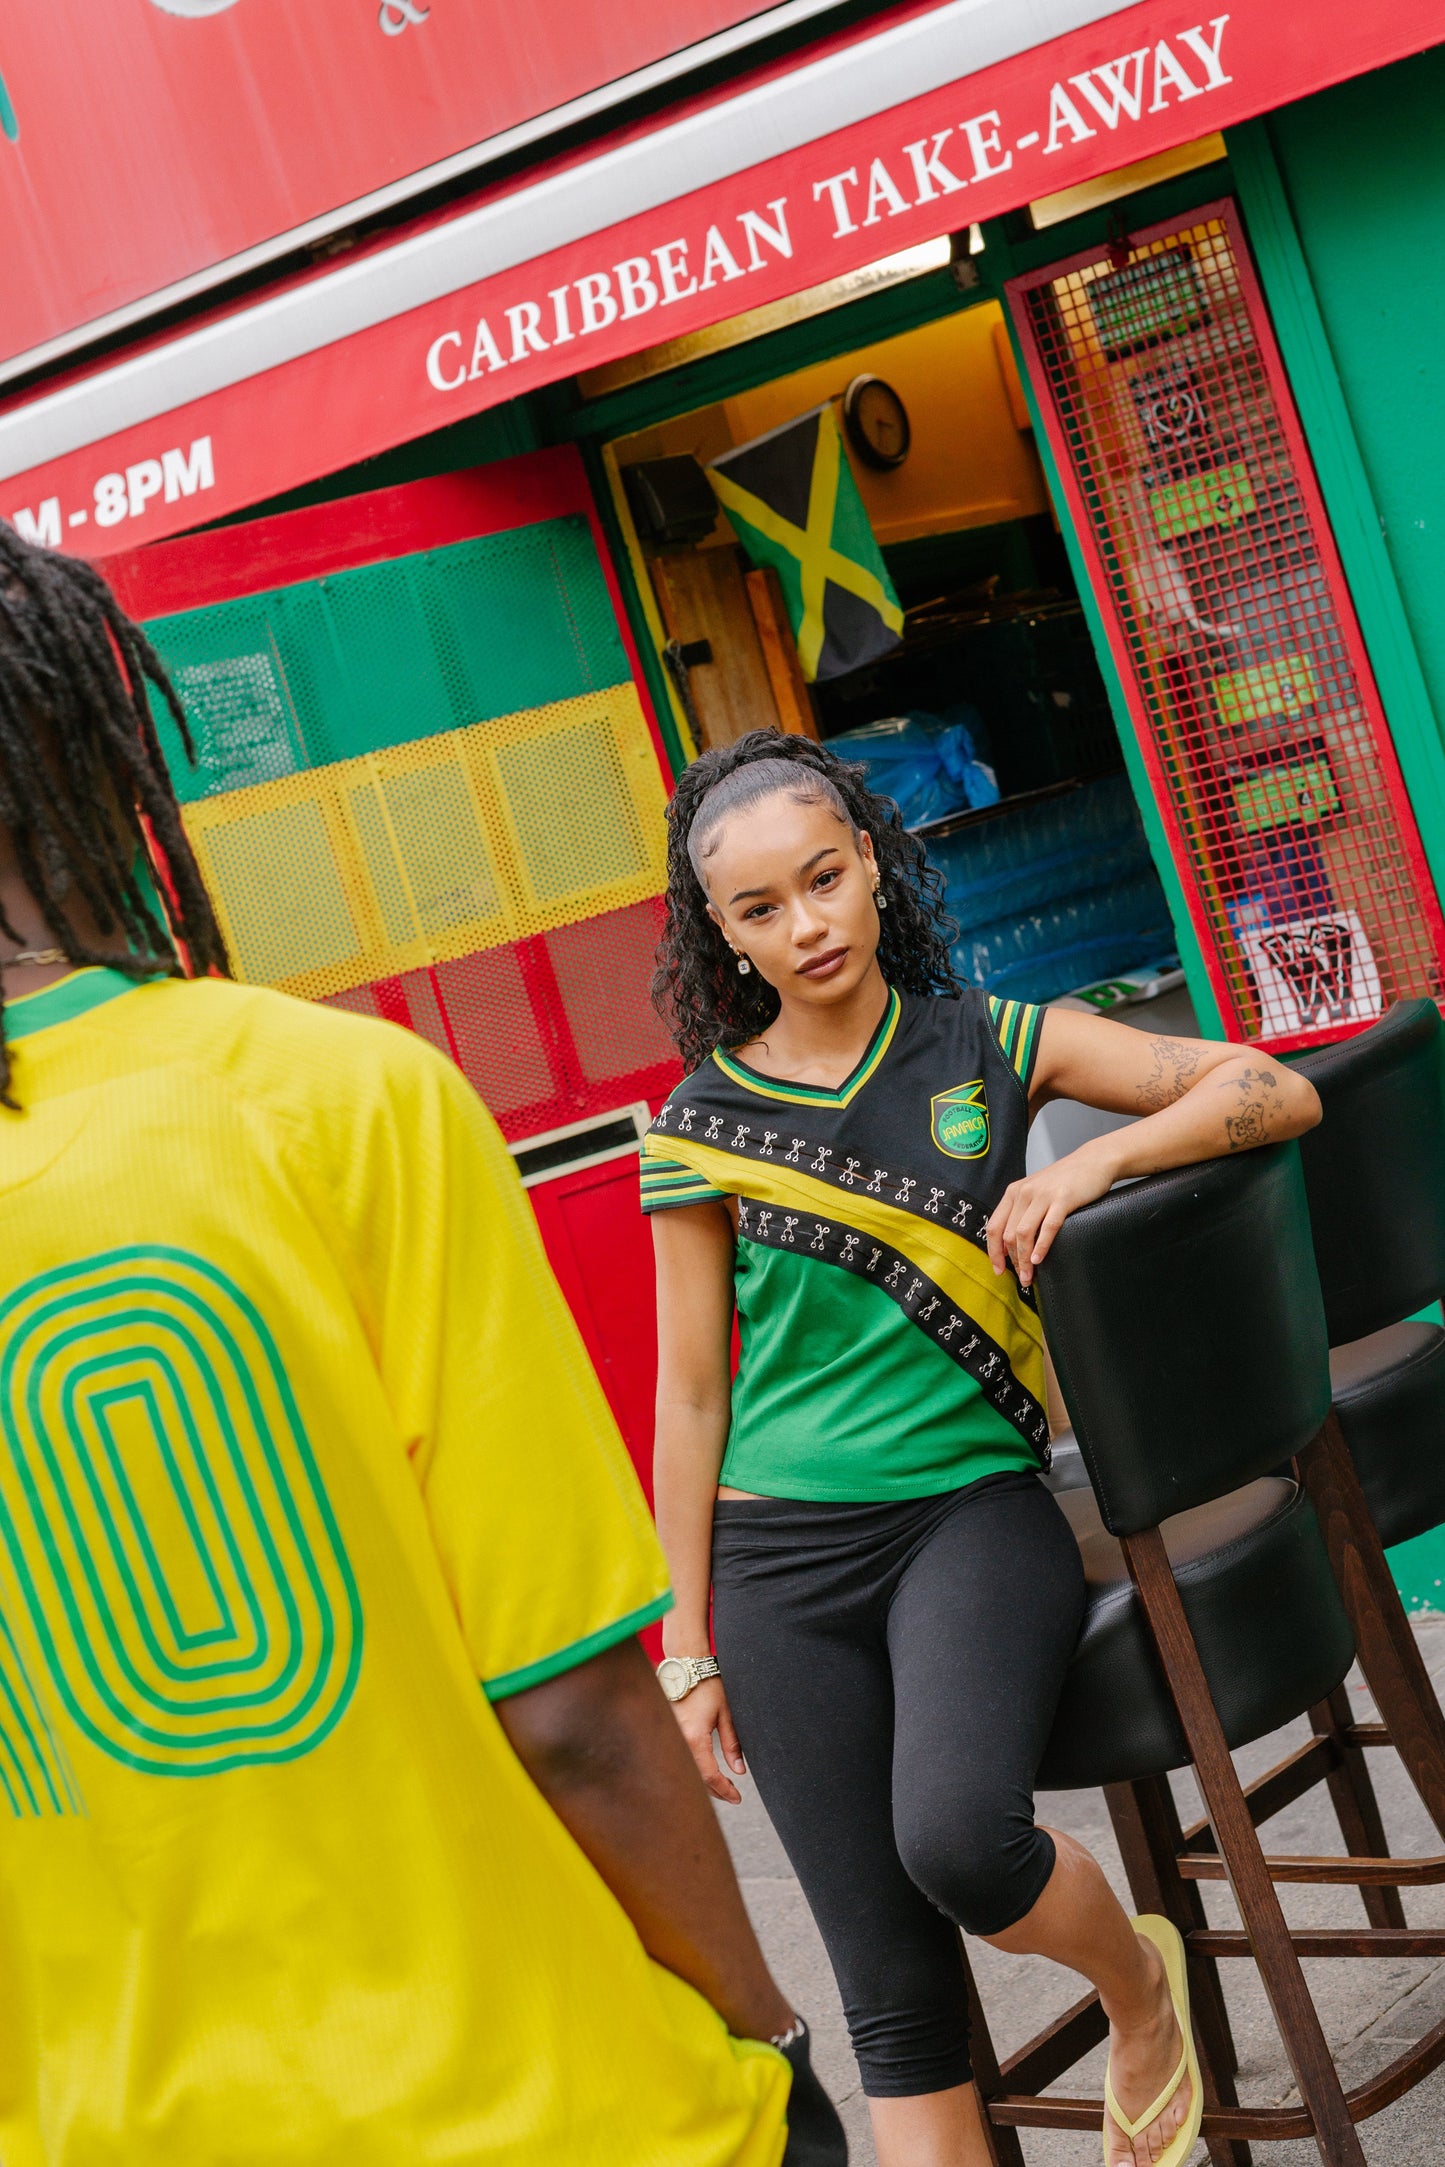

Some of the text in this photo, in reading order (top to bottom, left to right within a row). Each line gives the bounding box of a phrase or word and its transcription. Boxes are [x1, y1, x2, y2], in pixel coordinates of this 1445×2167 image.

[425, 13, 1234, 392] CARIBBEAN TAKE-AWAY
[942, 1105, 973, 1122] FOOTBALL
[941, 1116, 986, 1142] JAMAICA
[952, 1133, 985, 1150] FEDERATION
